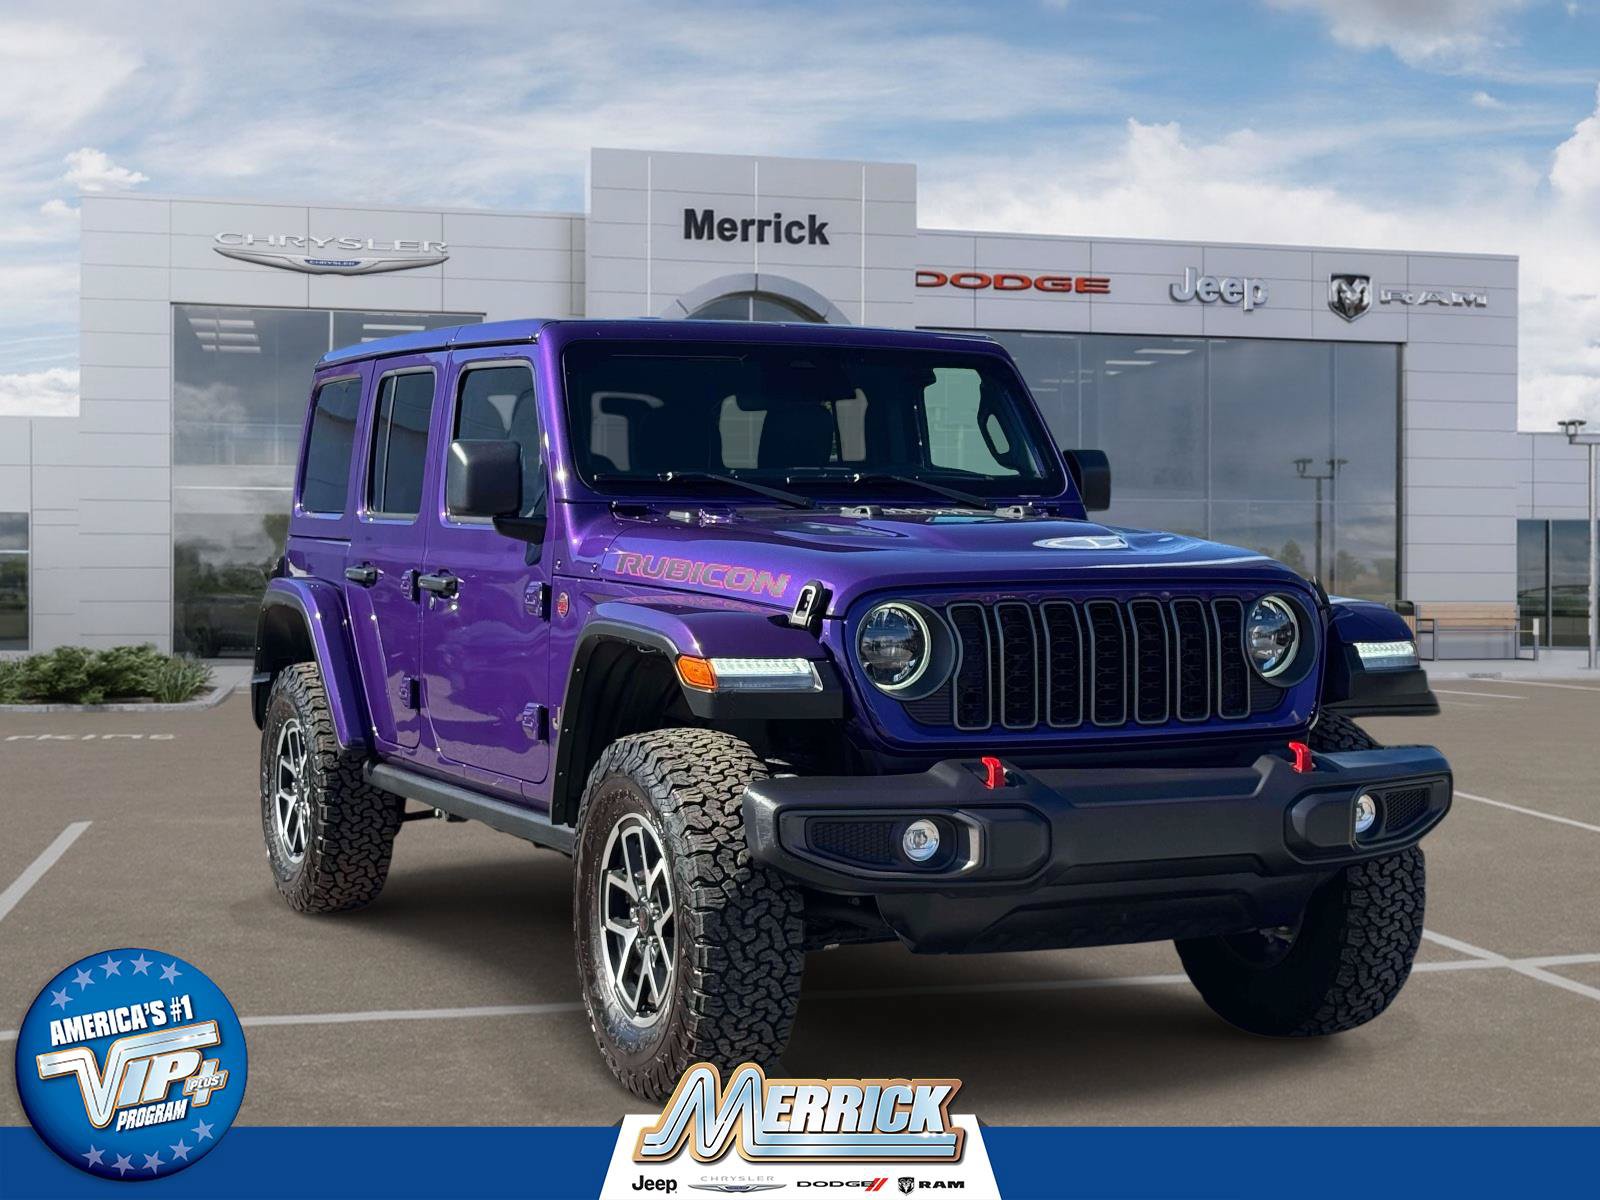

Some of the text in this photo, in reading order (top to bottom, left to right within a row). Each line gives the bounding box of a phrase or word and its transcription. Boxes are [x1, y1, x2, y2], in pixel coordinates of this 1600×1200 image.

[214, 231, 449, 253] CHRYSLER
[683, 208, 830, 246] Merrick
[915, 270, 1111, 294] DODGE
[1169, 265, 1268, 312] Jeep
[1379, 289, 1487, 308] RAM
[615, 552, 791, 598] RUBICON
